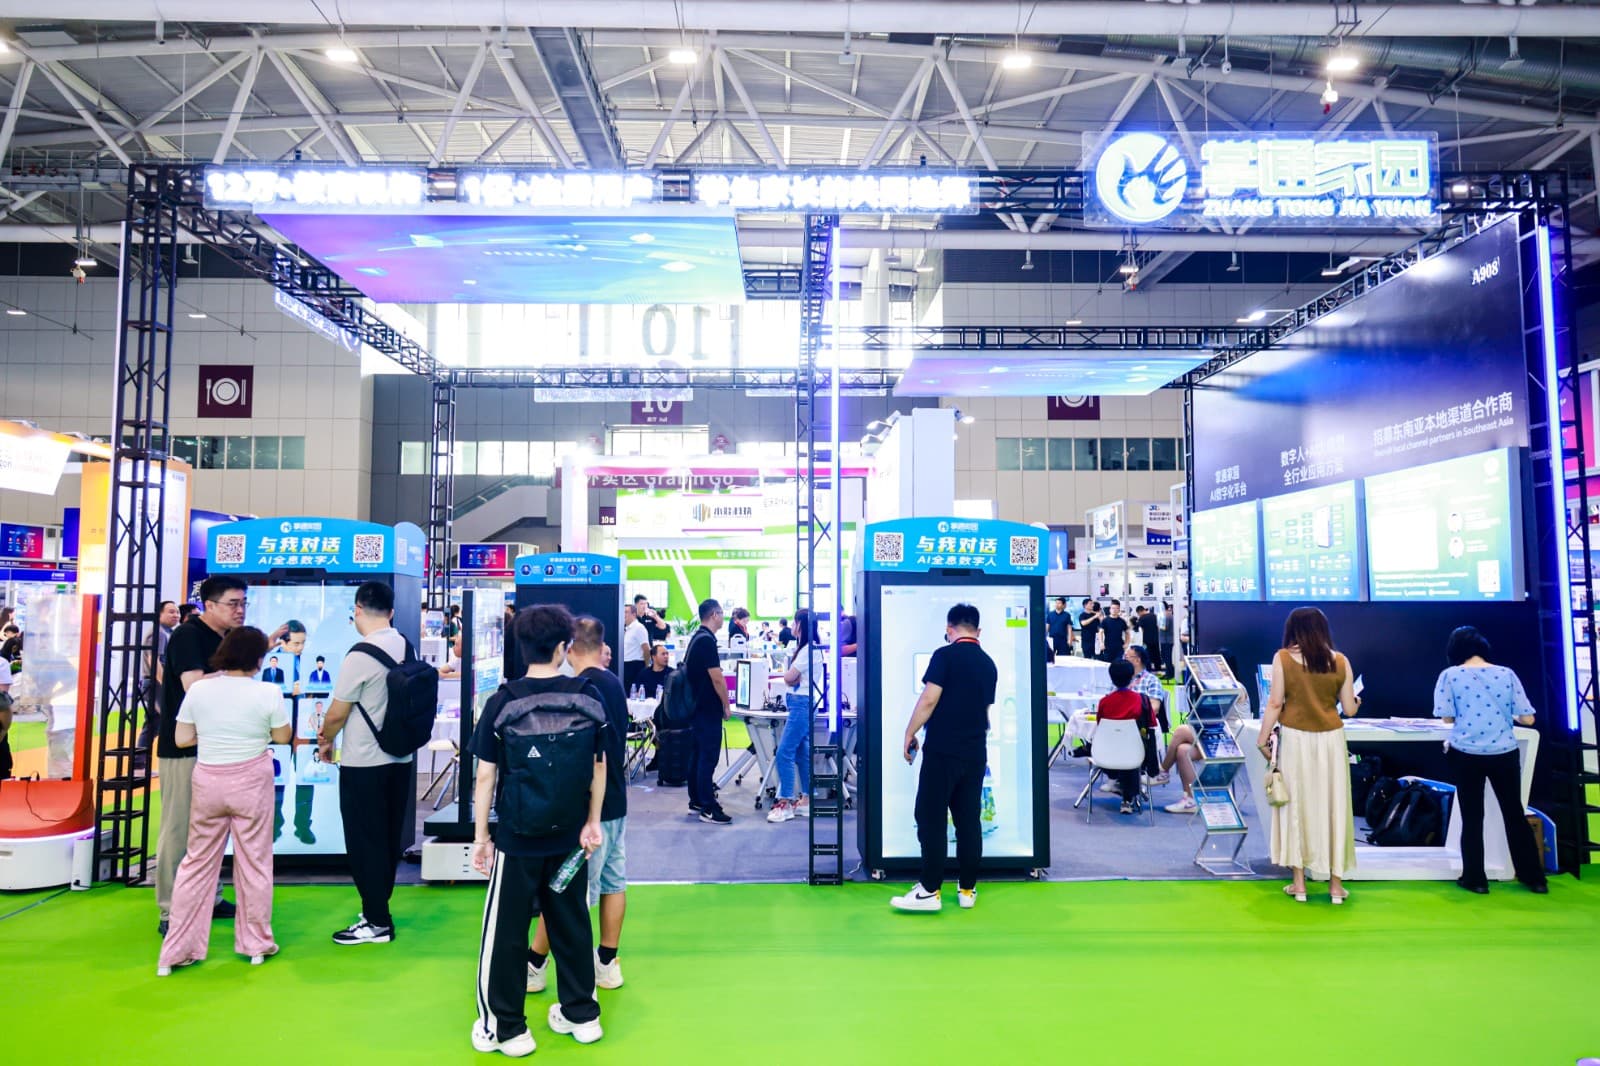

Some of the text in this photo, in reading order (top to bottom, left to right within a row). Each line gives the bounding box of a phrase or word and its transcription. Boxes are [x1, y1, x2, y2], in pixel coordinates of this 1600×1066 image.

[1201, 140, 1429, 195] 掌通家园
[1204, 199, 1430, 216] ZHANG TONG JIA YUAN
[1471, 260, 1498, 286] A908
[1456, 429, 1462, 438] in
[1463, 420, 1497, 437] Southeast
[1498, 415, 1514, 427] Asia
[258, 536, 342, 553] 与我对话
[916, 535, 998, 554] 与我对话
[258, 555, 340, 566] AI全息数字人
[917, 555, 997, 567] AI全息数字人
